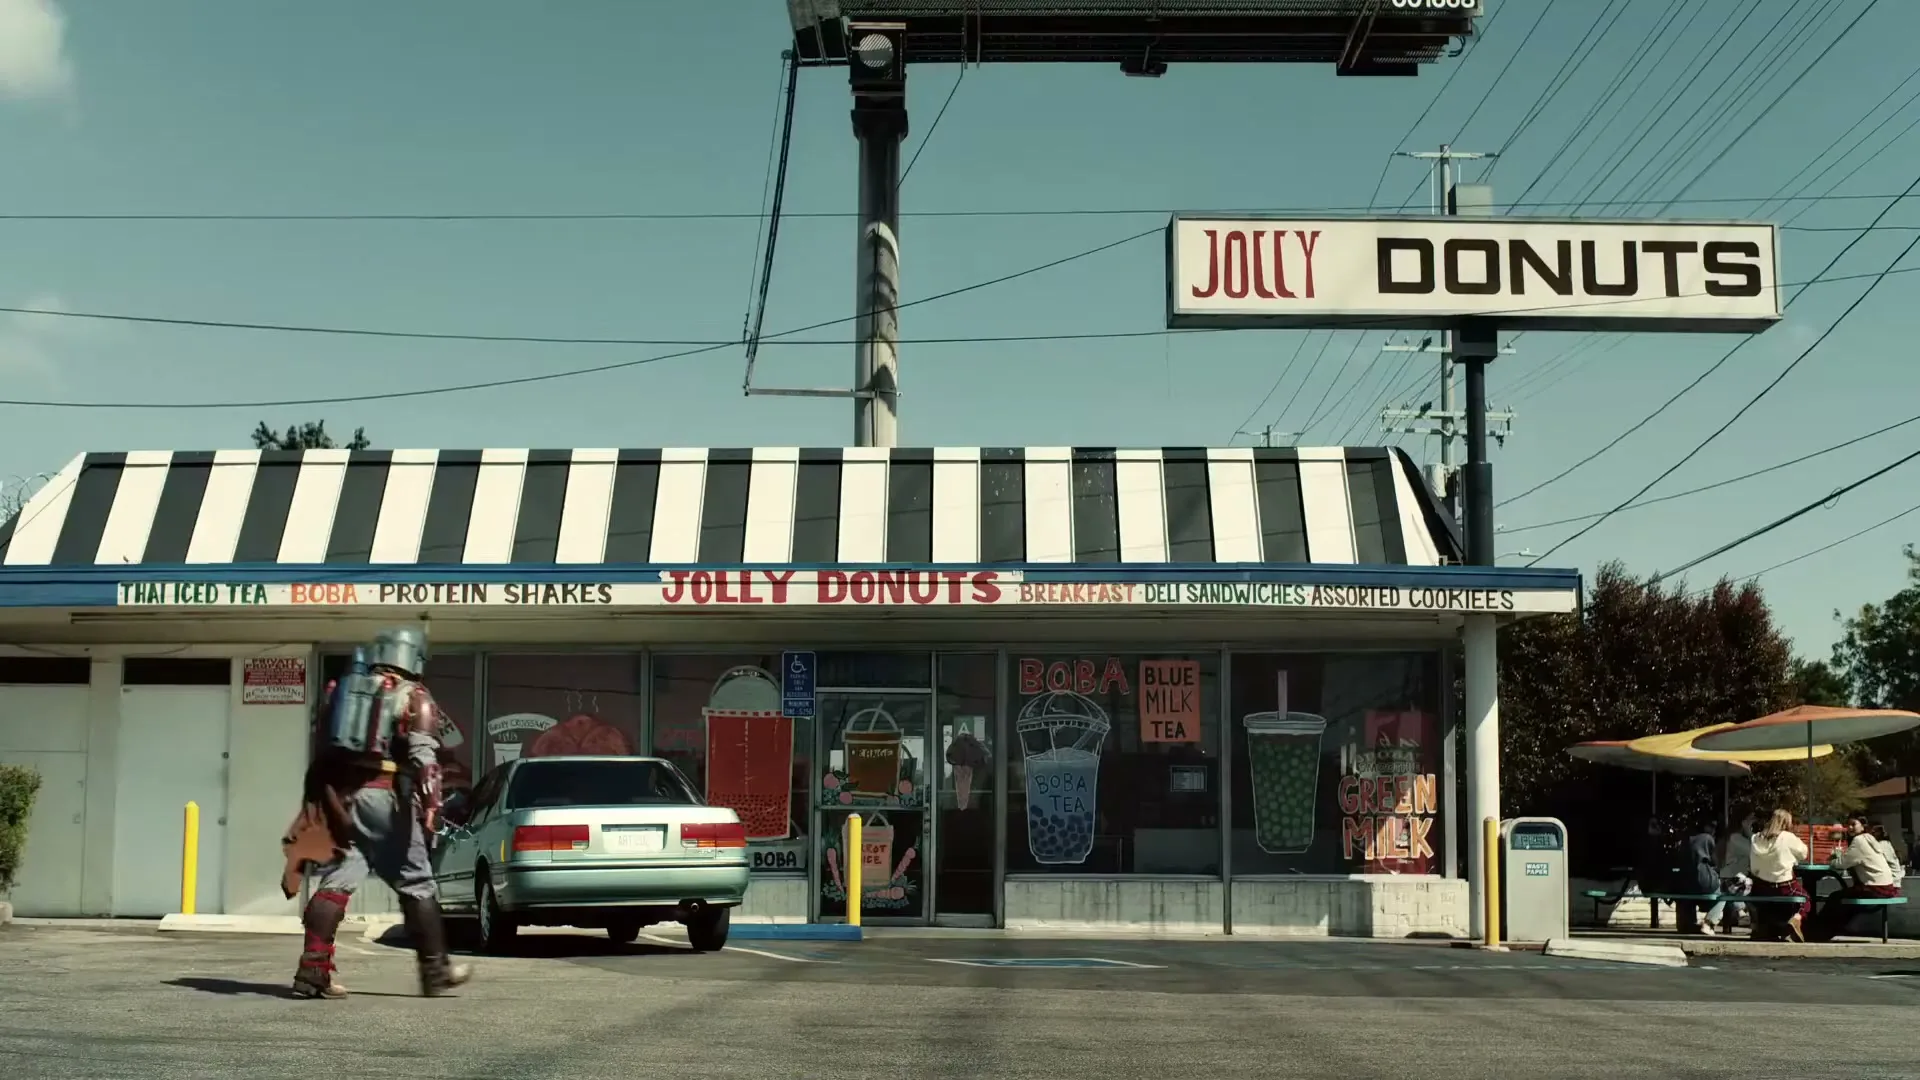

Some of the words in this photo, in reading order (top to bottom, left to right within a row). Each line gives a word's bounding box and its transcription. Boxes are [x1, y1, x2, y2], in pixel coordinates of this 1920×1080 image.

[1192, 229, 1322, 299] JOLLY
[1376, 236, 1762, 297] DONUTS
[121, 583, 166, 604] THAI
[174, 583, 219, 604] ICED
[226, 583, 268, 604] TEA
[291, 583, 358, 604] BOBA
[379, 583, 488, 604] PROTEIN
[504, 583, 613, 604] SHAKES
[661, 571, 797, 604] JOLLY
[817, 570, 1002, 604] DONUTS
[1020, 583, 1137, 603] BREAKFAST
[1145, 583, 1181, 604] DELI
[1186, 583, 1305, 606] SANDWICHES
[1311, 585, 1400, 607] ASSORTED
[1409, 587, 1514, 610] COOKIEES
[1019, 657, 1130, 695] BOBA
[1144, 667, 1194, 686] BLUE
[1146, 690, 1193, 715] MILK
[958, 722, 970, 736] A
[1150, 720, 1187, 739] TEA
[1034, 772, 1088, 795] BOBA
[1338, 773, 1437, 814] GREEN
[1048, 795, 1086, 813] TEA
[1343, 816, 1435, 860] MILK
[753, 850, 797, 867] BOBA
